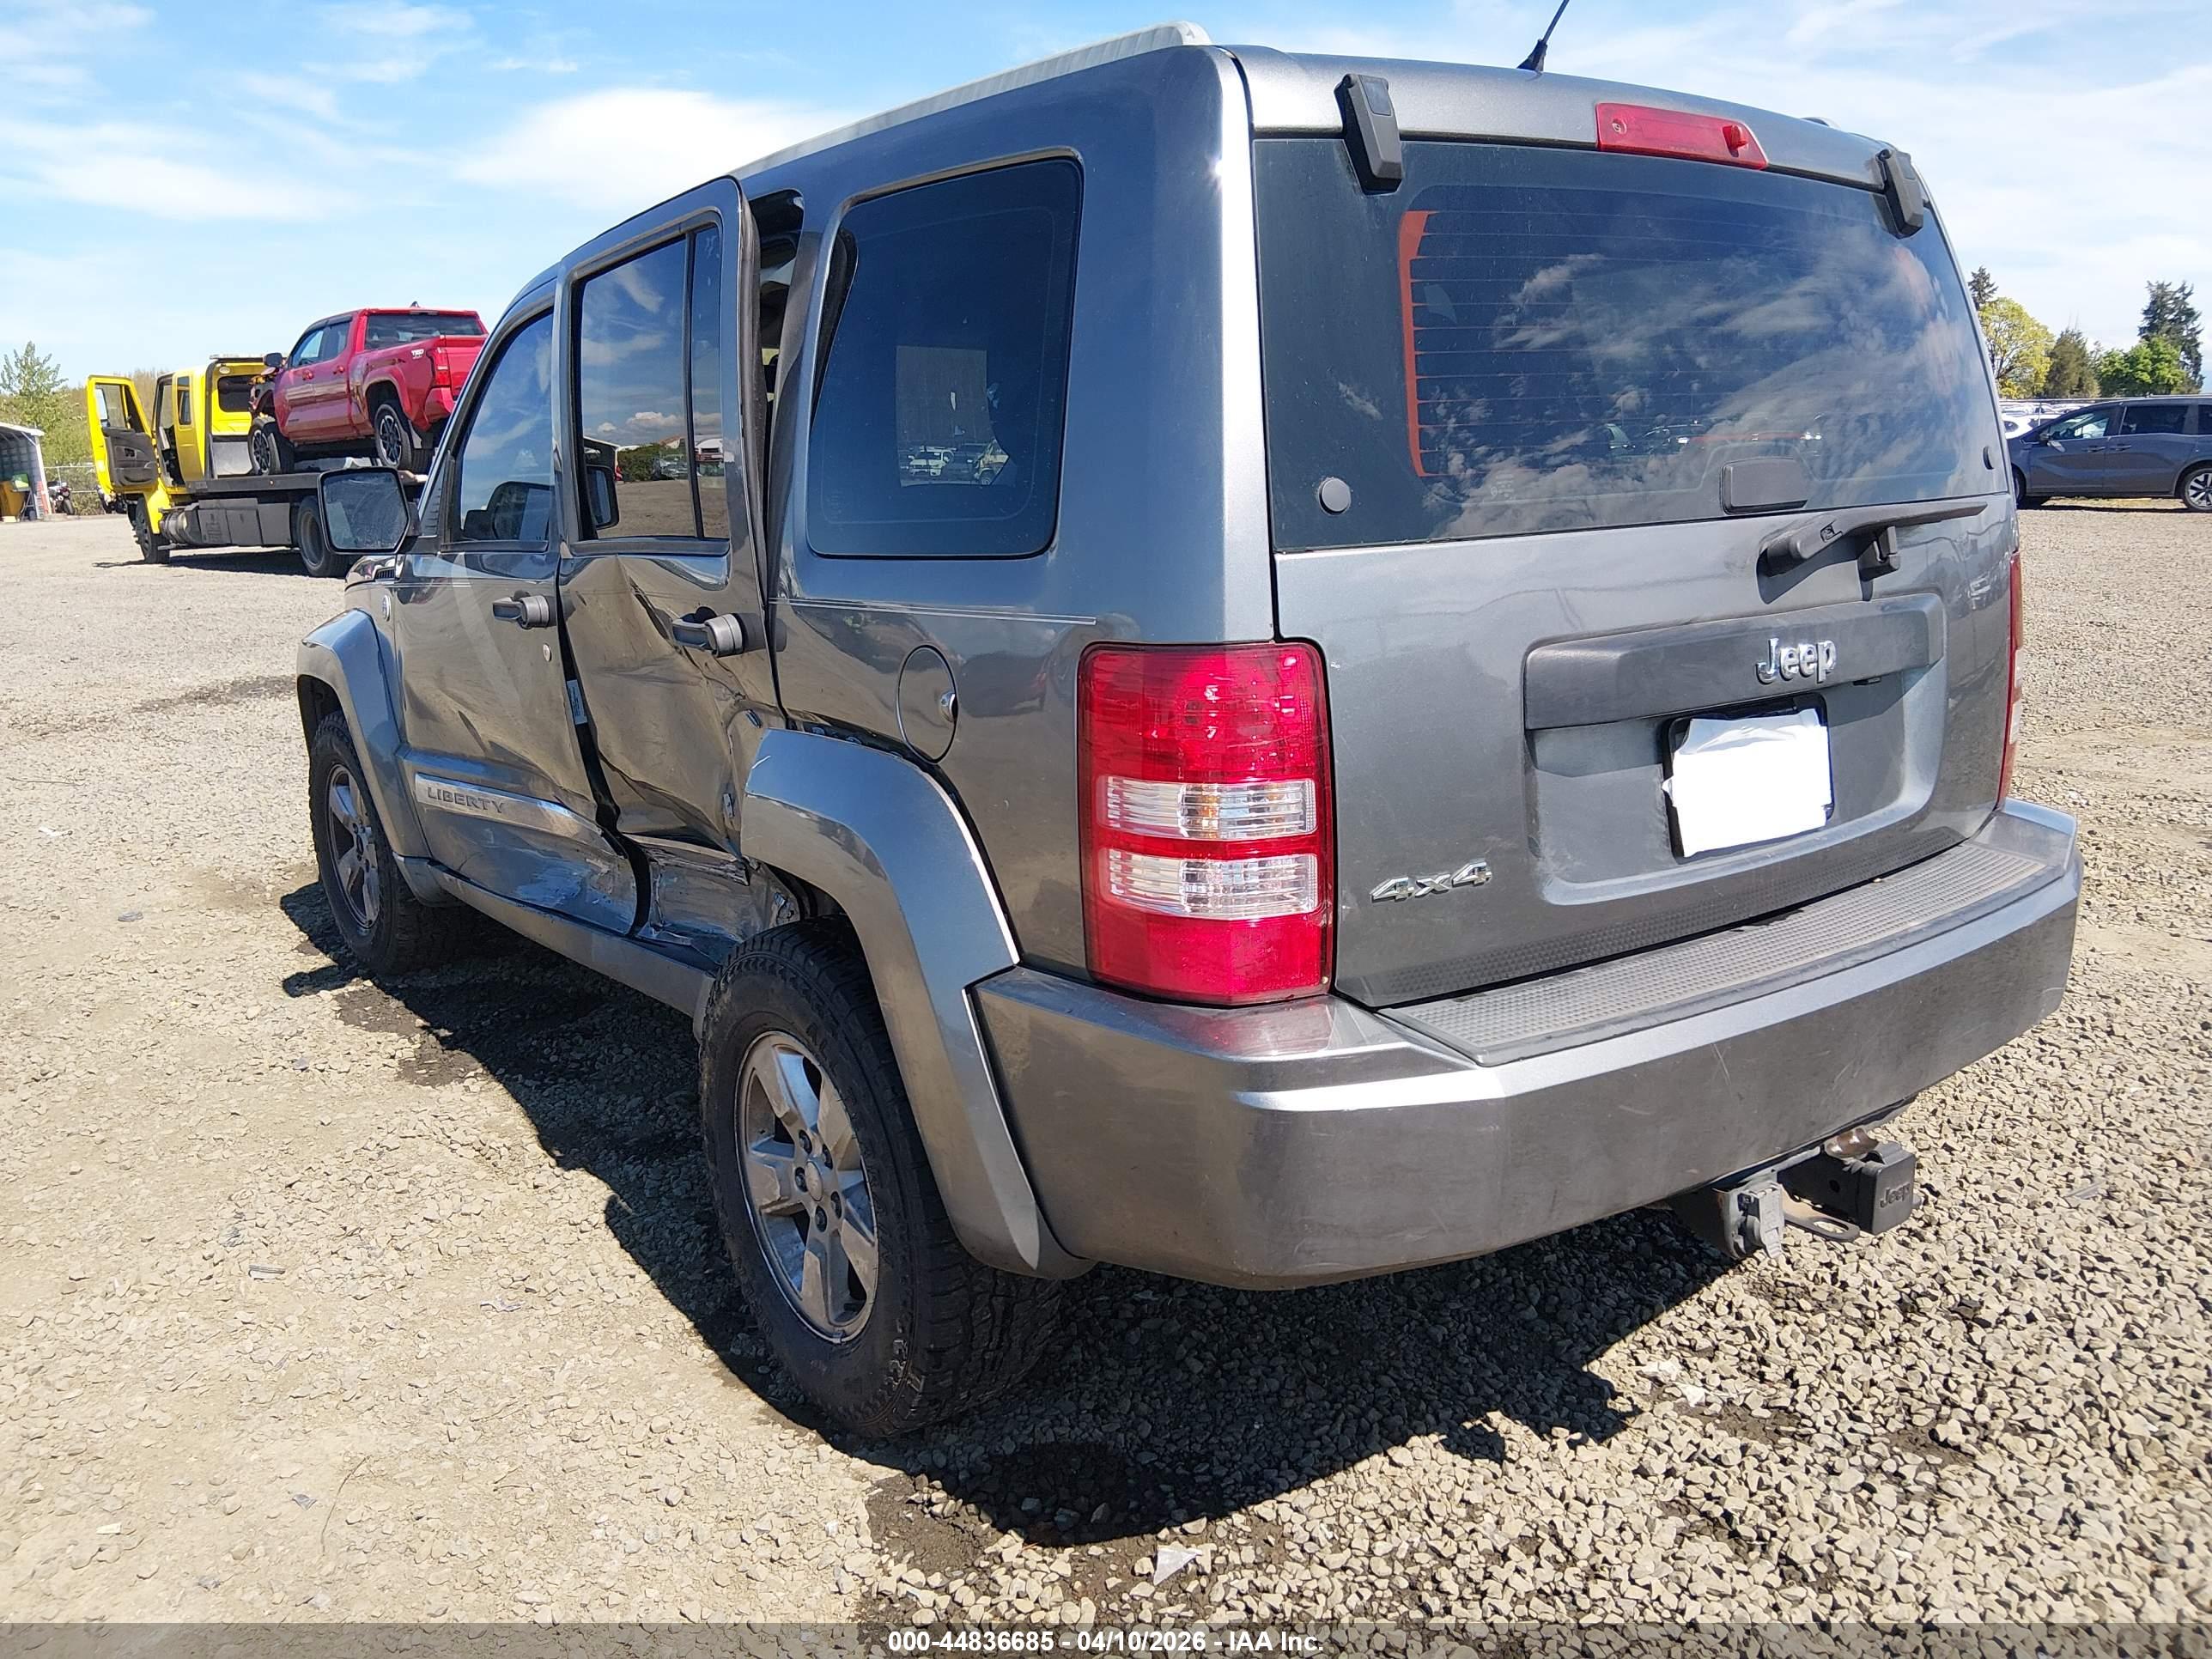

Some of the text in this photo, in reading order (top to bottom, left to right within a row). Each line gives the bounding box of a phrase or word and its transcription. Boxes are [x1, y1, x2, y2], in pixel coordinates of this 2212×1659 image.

[1755, 637, 1837, 685] Jeep
[427, 786, 505, 814] LIBERTY
[1370, 858, 1493, 904] 4x4
[1880, 1182, 1911, 1209] Jeep
